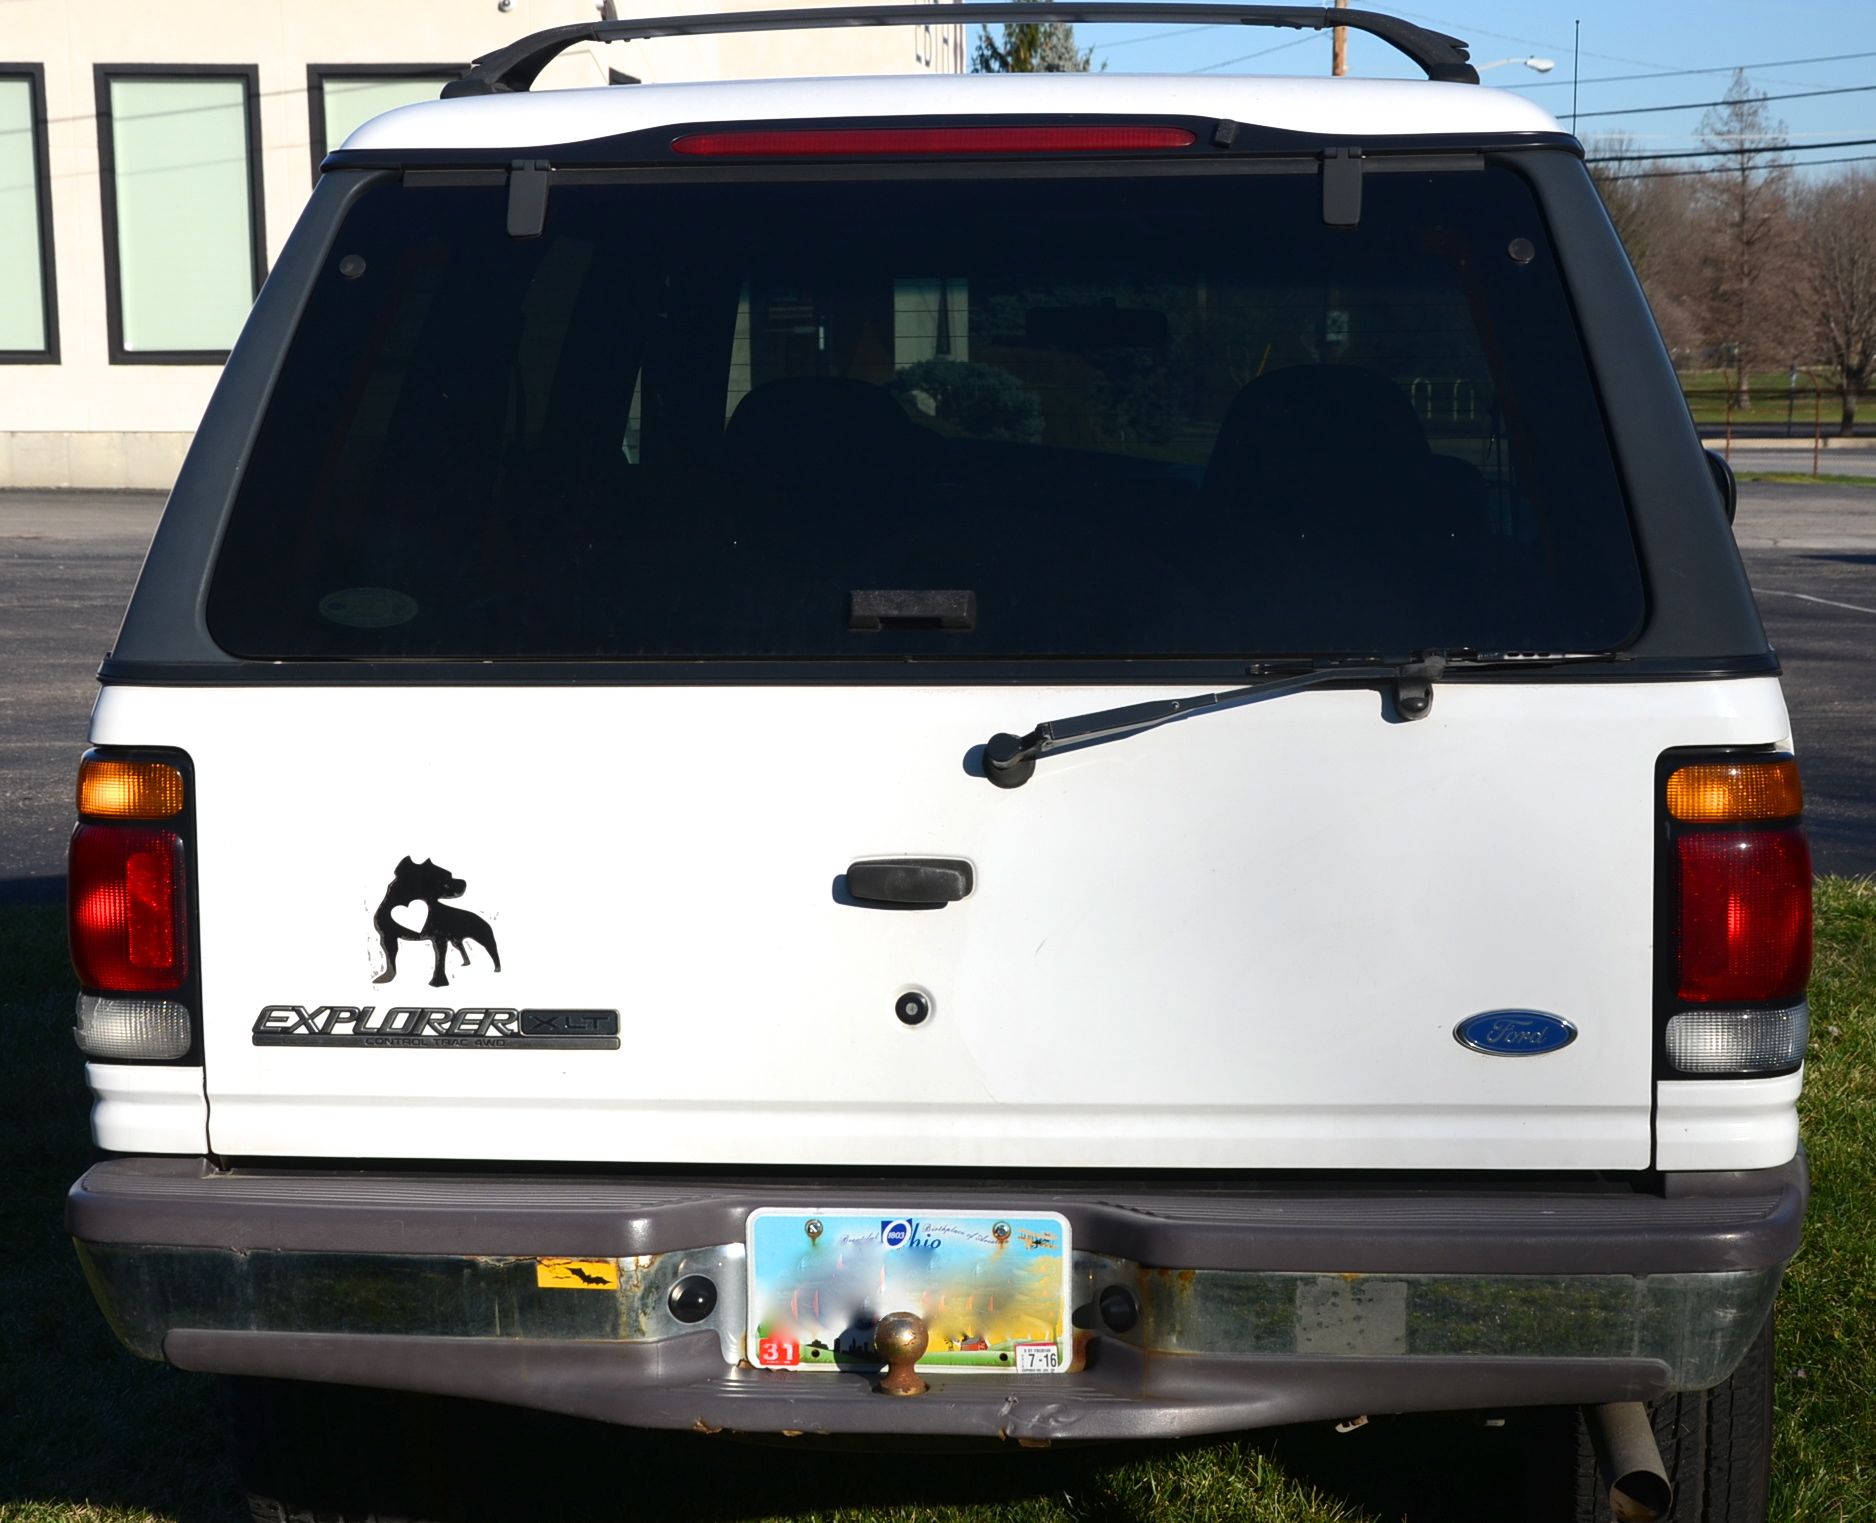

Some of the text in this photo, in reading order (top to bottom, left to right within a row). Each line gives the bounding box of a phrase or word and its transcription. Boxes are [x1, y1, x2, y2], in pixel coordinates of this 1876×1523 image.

[252, 1005, 611, 1035] EXPLORER XLT
[1486, 1019, 1549, 1043] Ford
[364, 1037, 506, 1048] CONTROL TRAC 4WD
[882, 1219, 942, 1250] Ohio
[887, 1231, 905, 1240] 1803
[763, 1343, 793, 1361] 31
